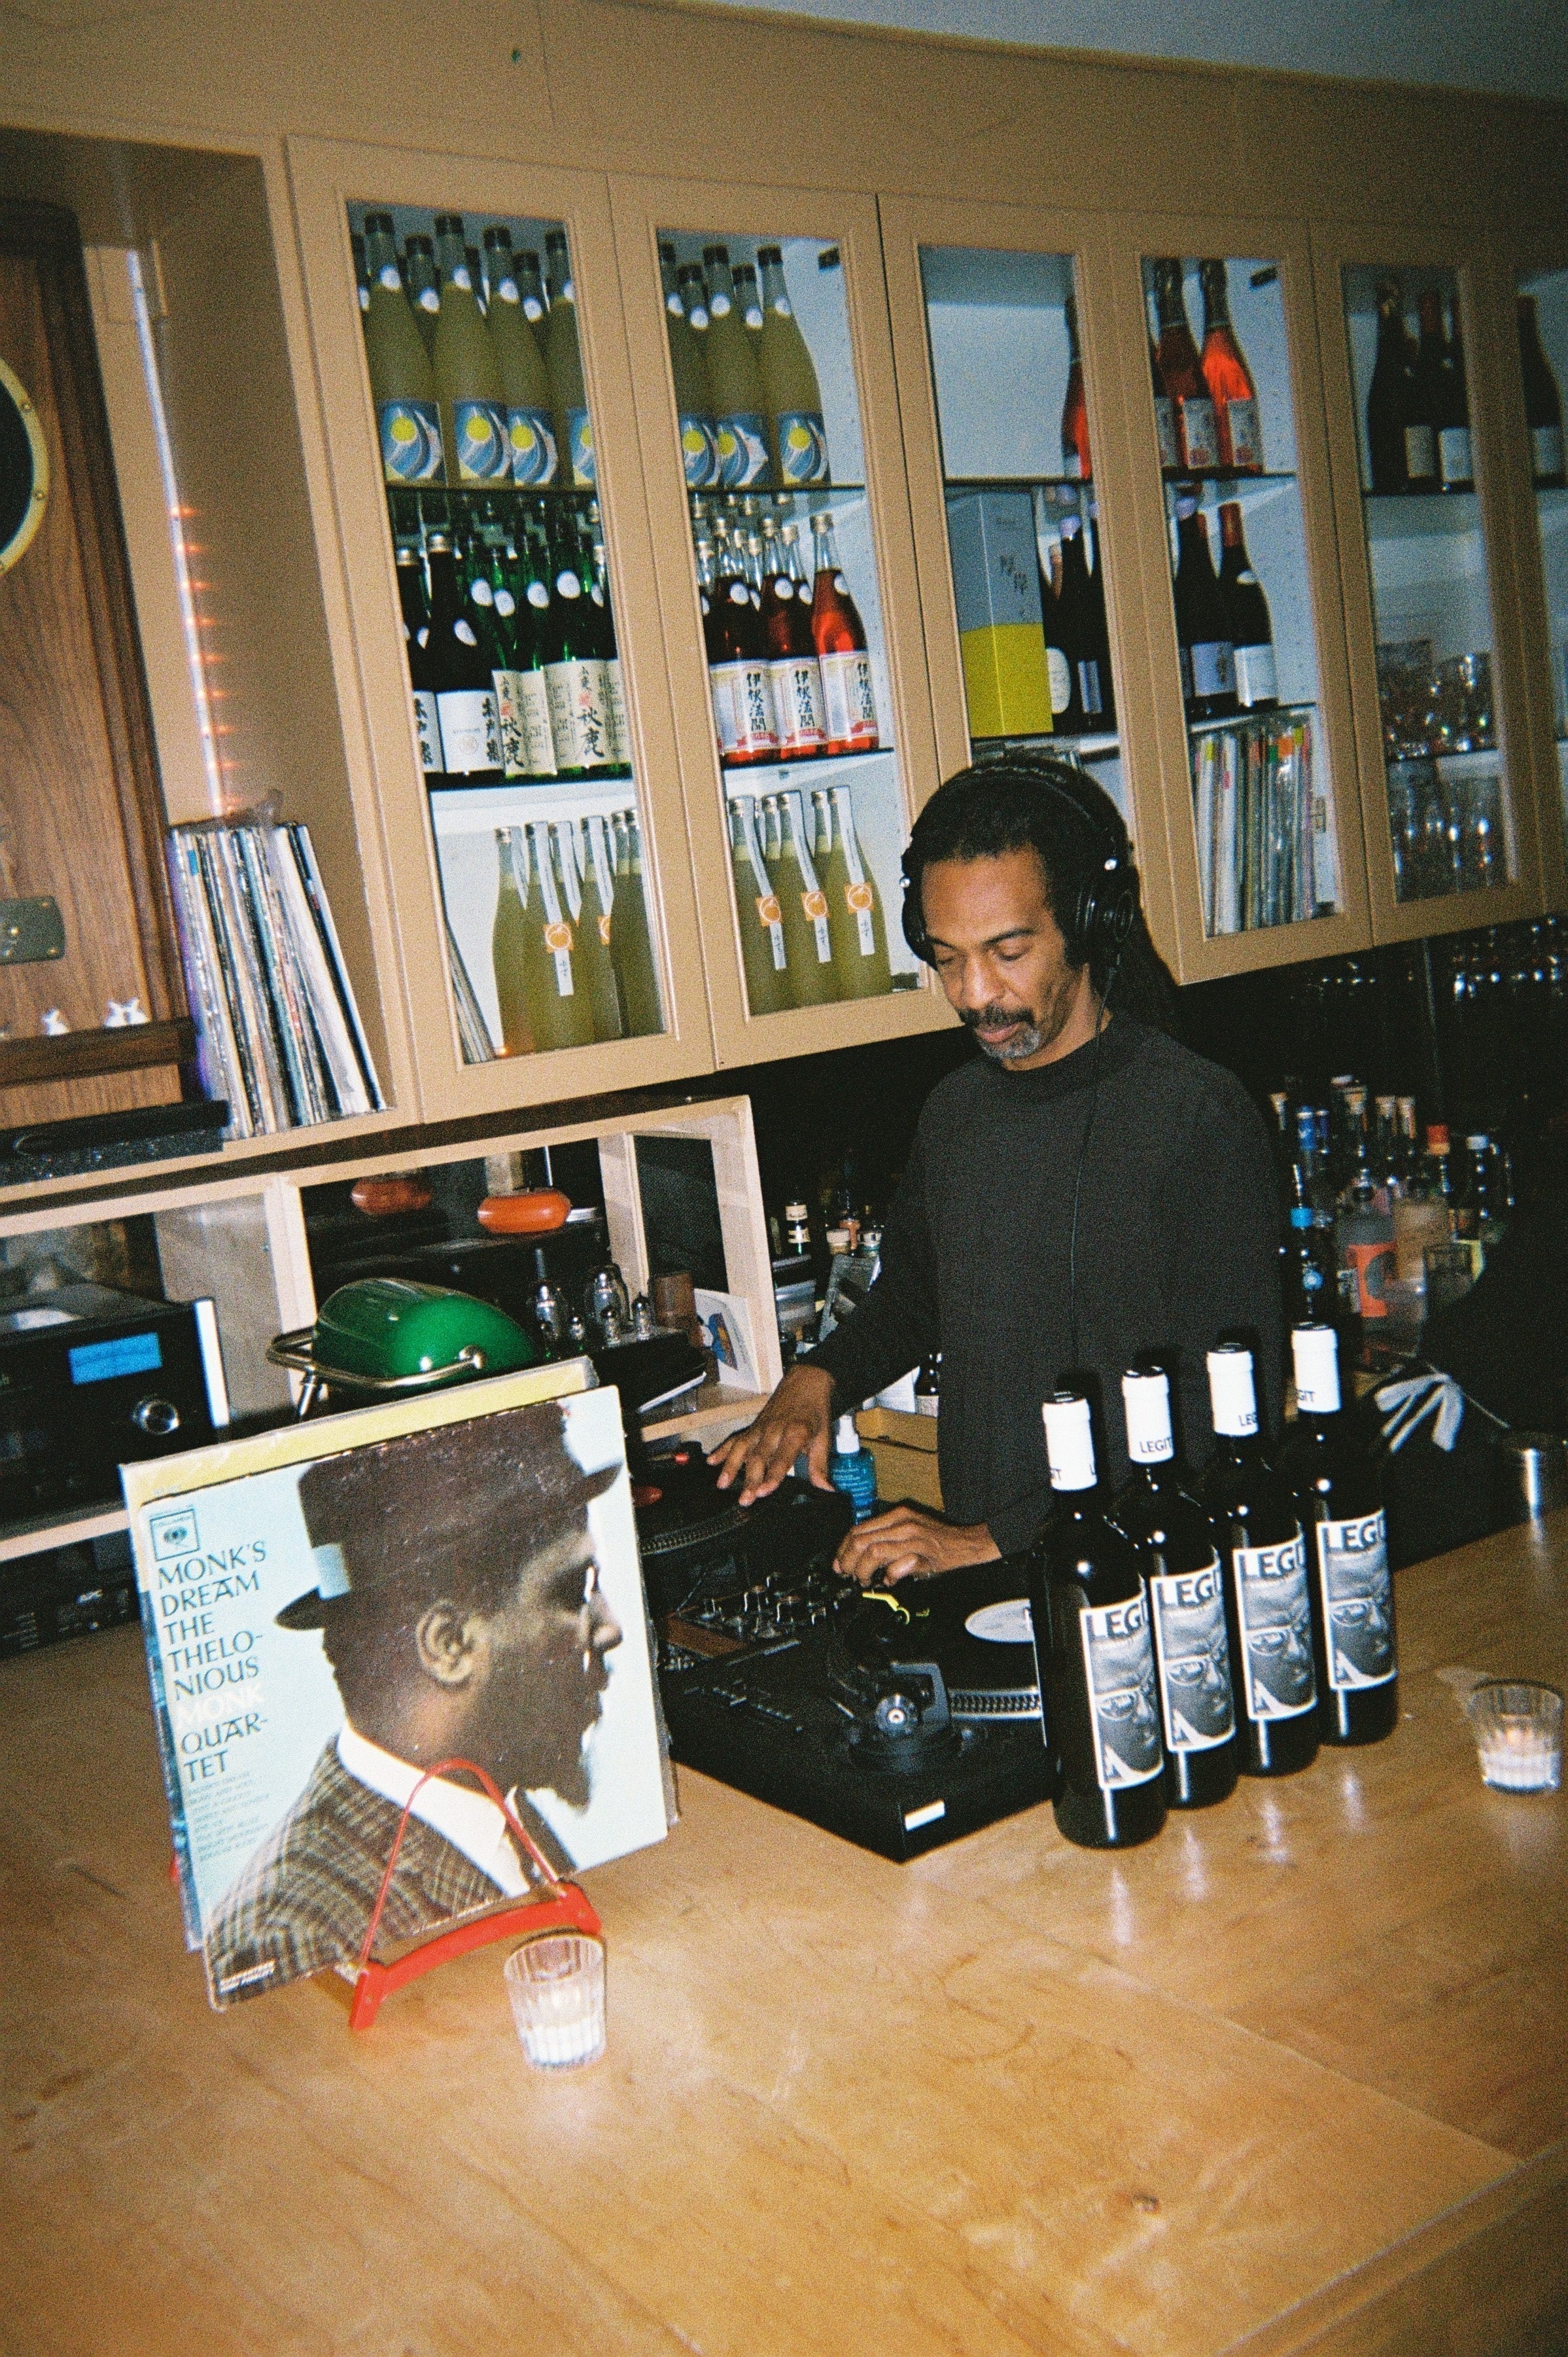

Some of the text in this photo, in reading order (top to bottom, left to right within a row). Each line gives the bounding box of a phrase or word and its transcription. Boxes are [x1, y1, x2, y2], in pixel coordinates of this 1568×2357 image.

[1297, 1389, 1315, 1402] GIT
[1321, 1515, 1385, 1553] LEGI
[158, 1540, 267, 1589] MONK'S
[1238, 1542, 1306, 1581] LEGI
[160, 1570, 260, 1618] DREAM
[1155, 1570, 1221, 1608] LEGI
[163, 1612, 215, 1645] THE
[1085, 1598, 1147, 1641] LEGI
[167, 1630, 263, 1673] THELO-
[173, 1656, 260, 1701] NIOUS
[175, 1683, 265, 1730] MONK
[181, 1712, 268, 1754] QUAR-
[183, 1748, 228, 1782] TET
